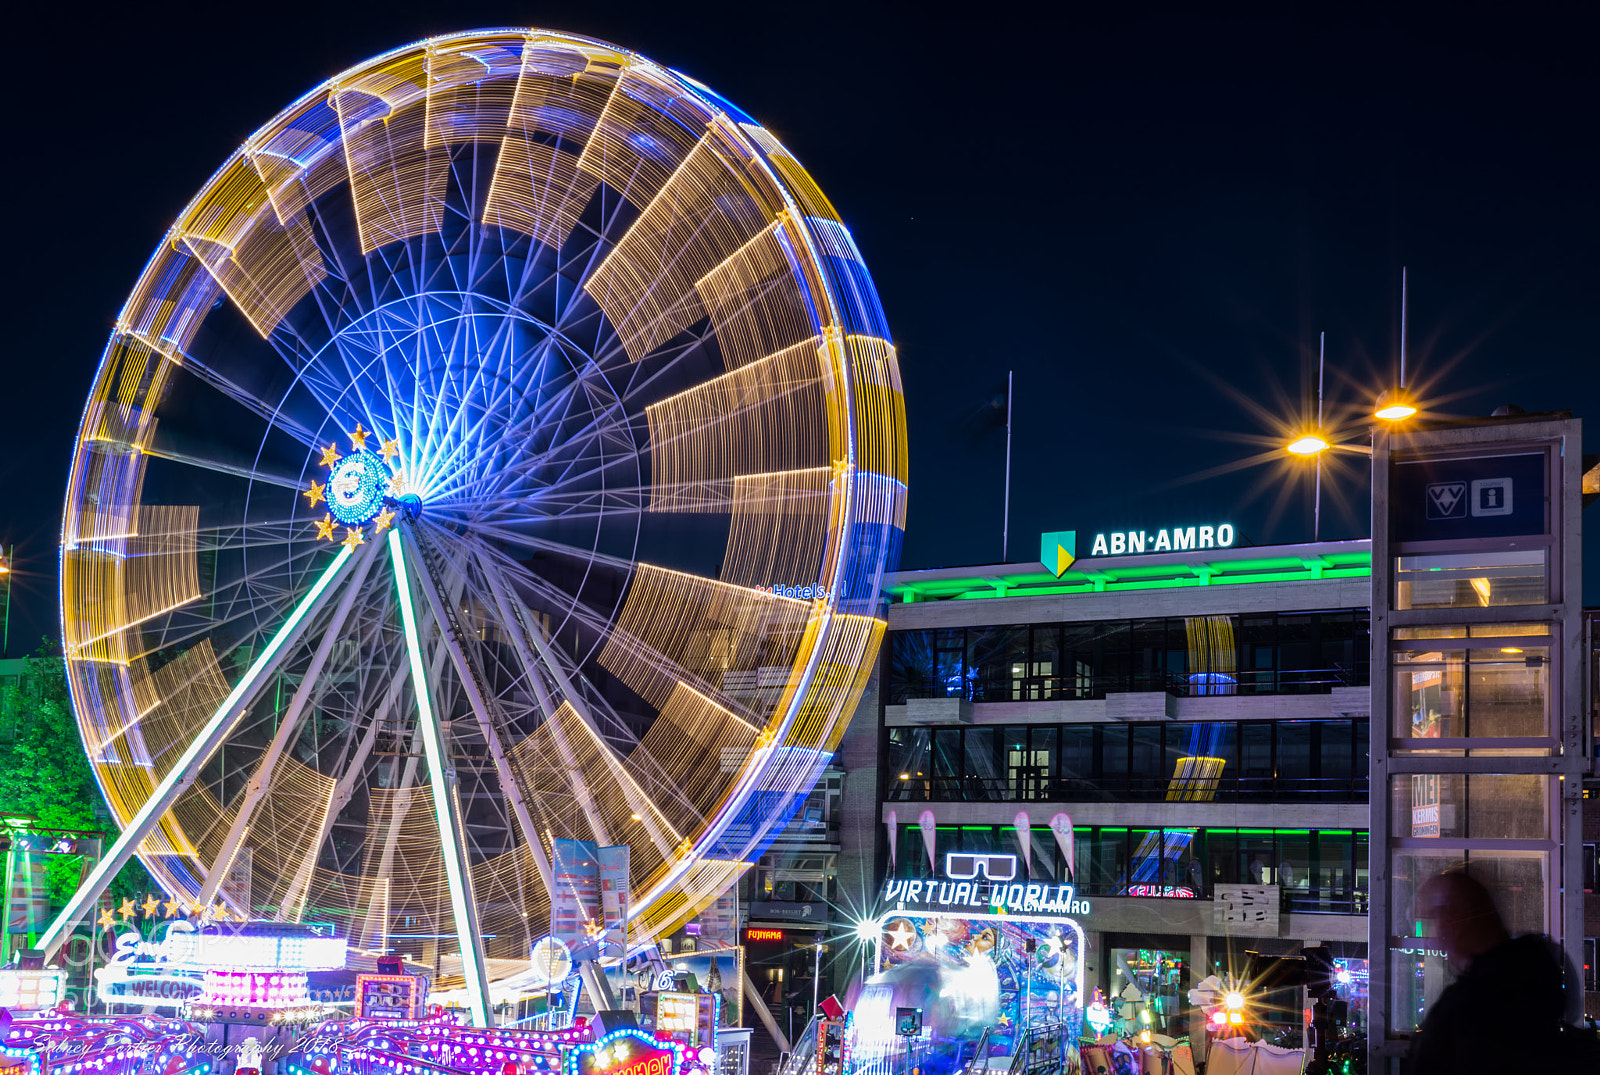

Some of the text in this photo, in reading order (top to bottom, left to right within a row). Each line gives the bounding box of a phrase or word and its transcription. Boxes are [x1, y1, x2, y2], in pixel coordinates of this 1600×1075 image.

[1412, 806, 1439, 824] KERMIS
[885, 879, 1075, 909] VIRTUAL WORLD
[748, 930, 782, 941] FUJIYAMA
